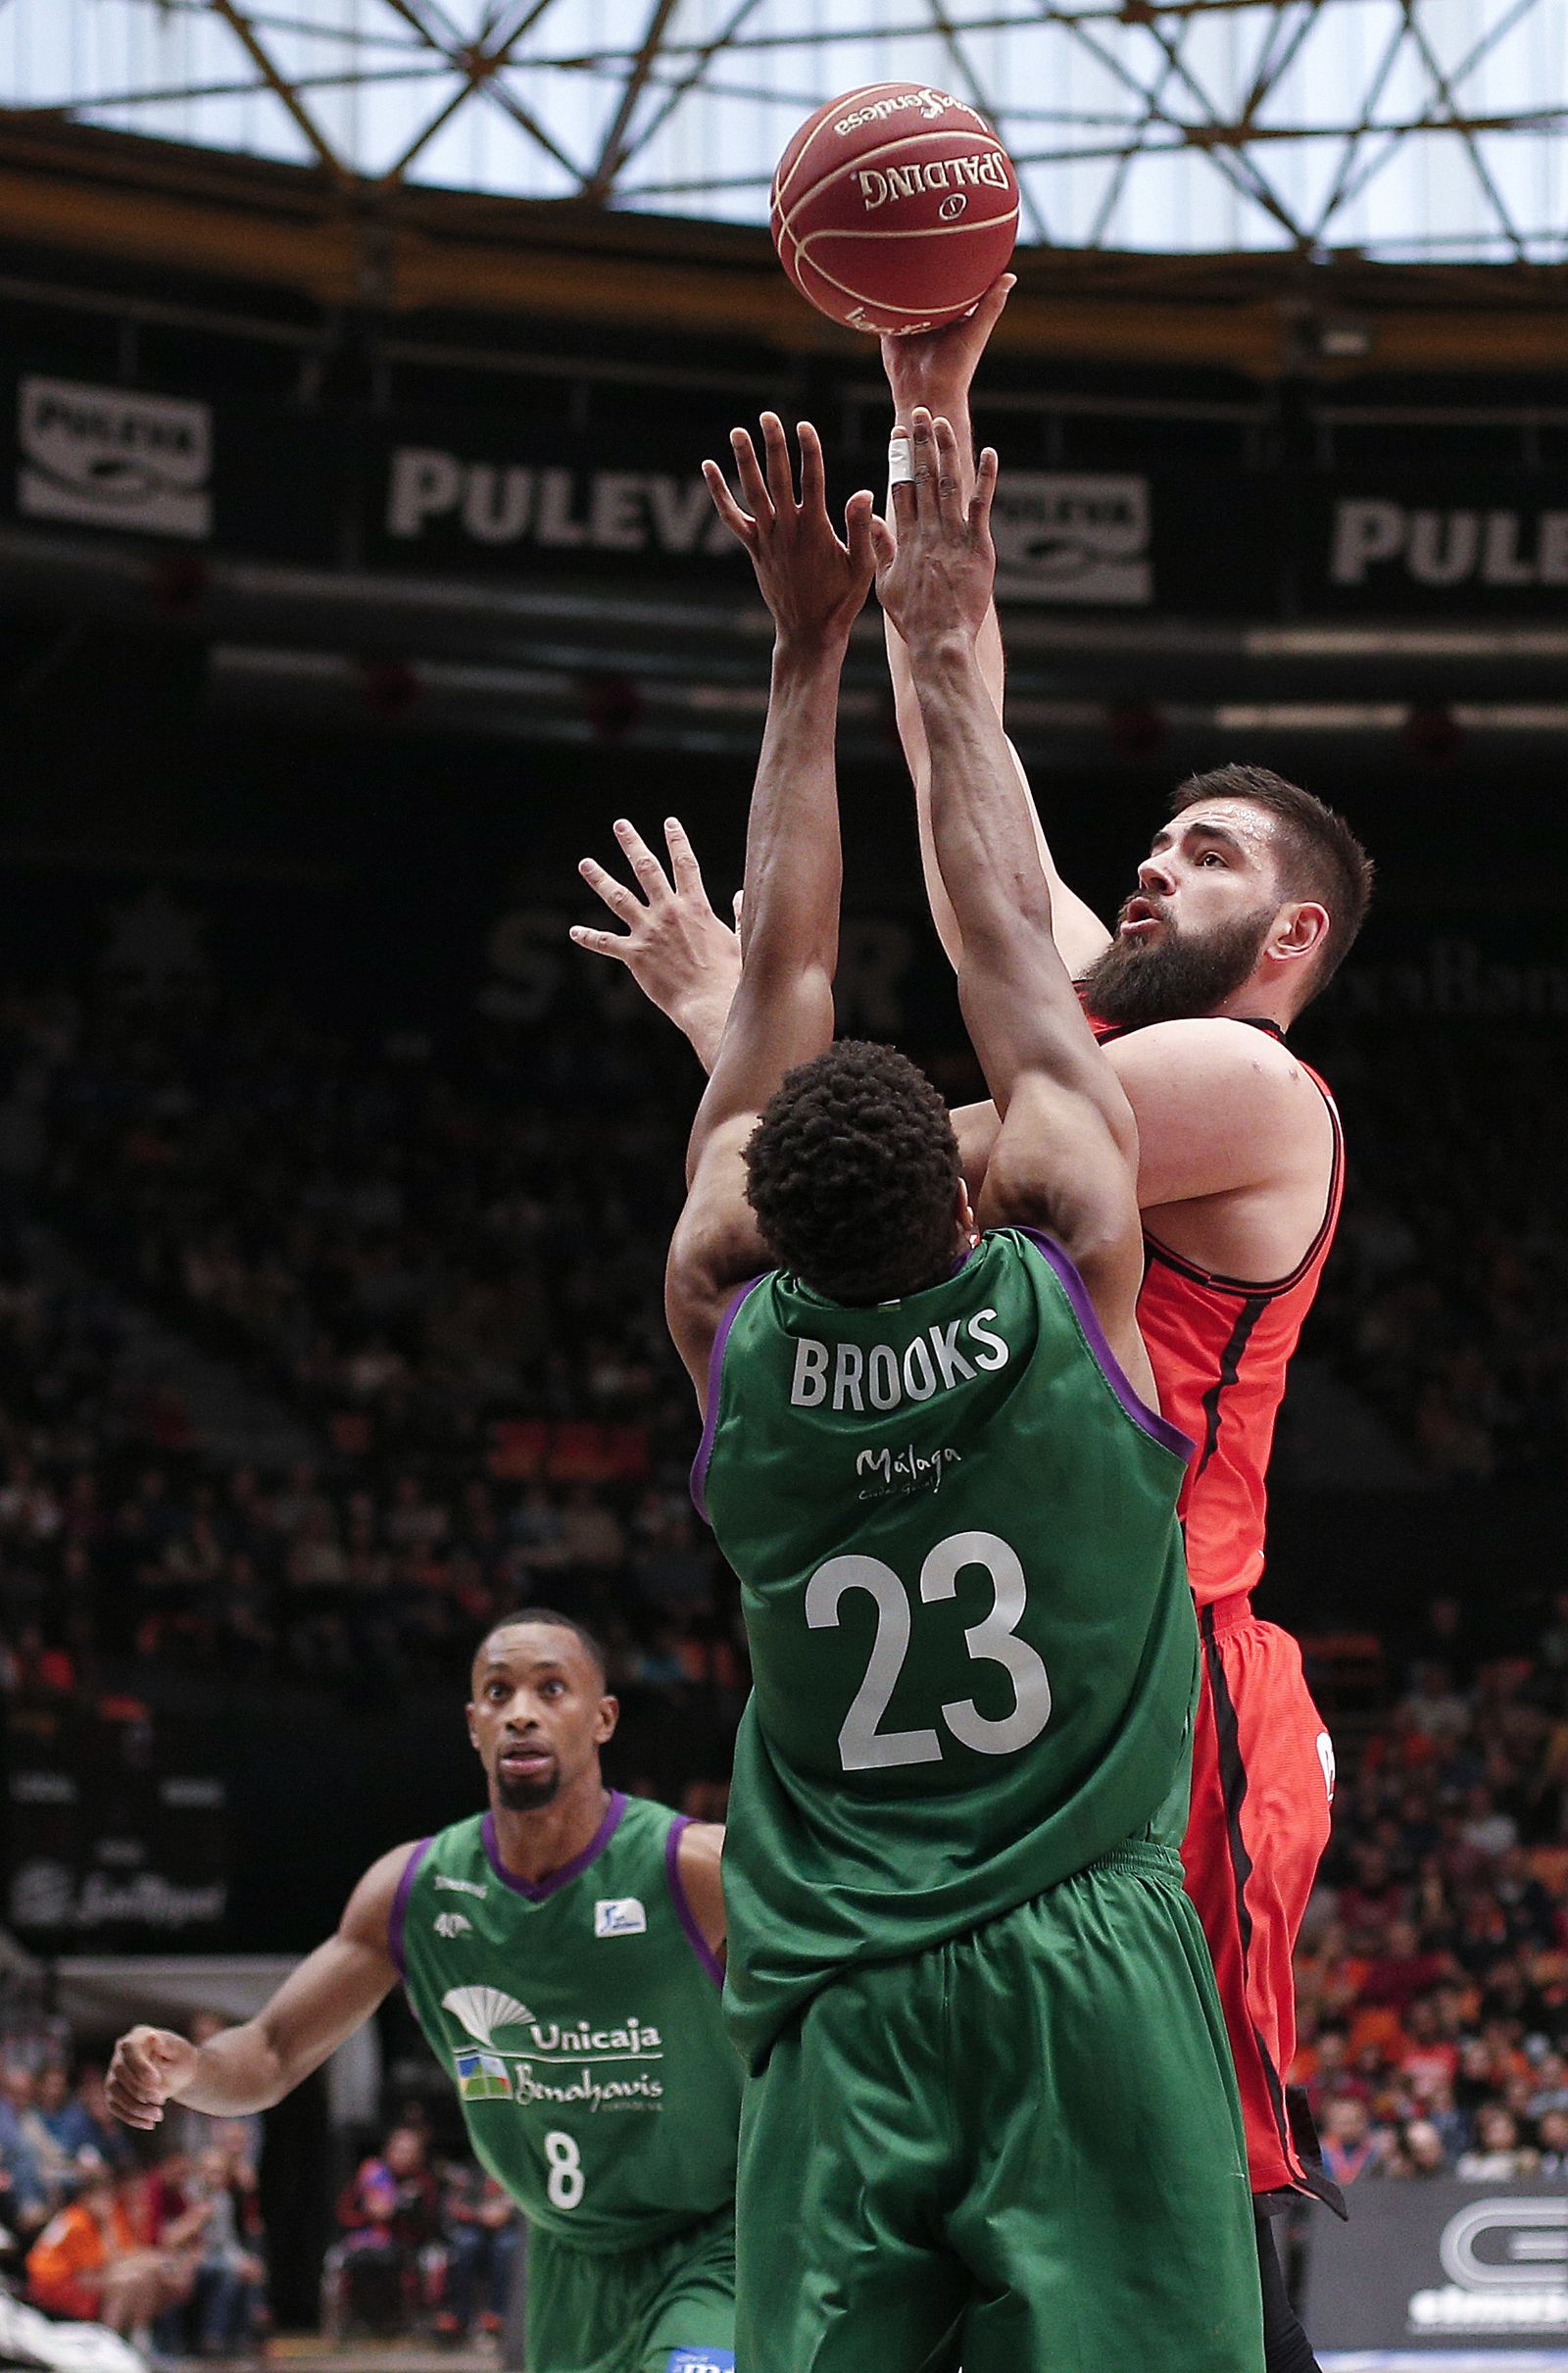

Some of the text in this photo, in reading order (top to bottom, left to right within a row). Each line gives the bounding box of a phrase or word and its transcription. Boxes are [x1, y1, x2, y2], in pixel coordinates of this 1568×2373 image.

[858, 152, 1009, 212] SPALDING
[790, 1309, 1010, 1411] BROOKS
[857, 1444, 961, 1494] Málaga
[806, 1531, 1052, 1771] 23
[530, 2017, 662, 2053] Unicaja
[544, 2131, 585, 2211] 8
